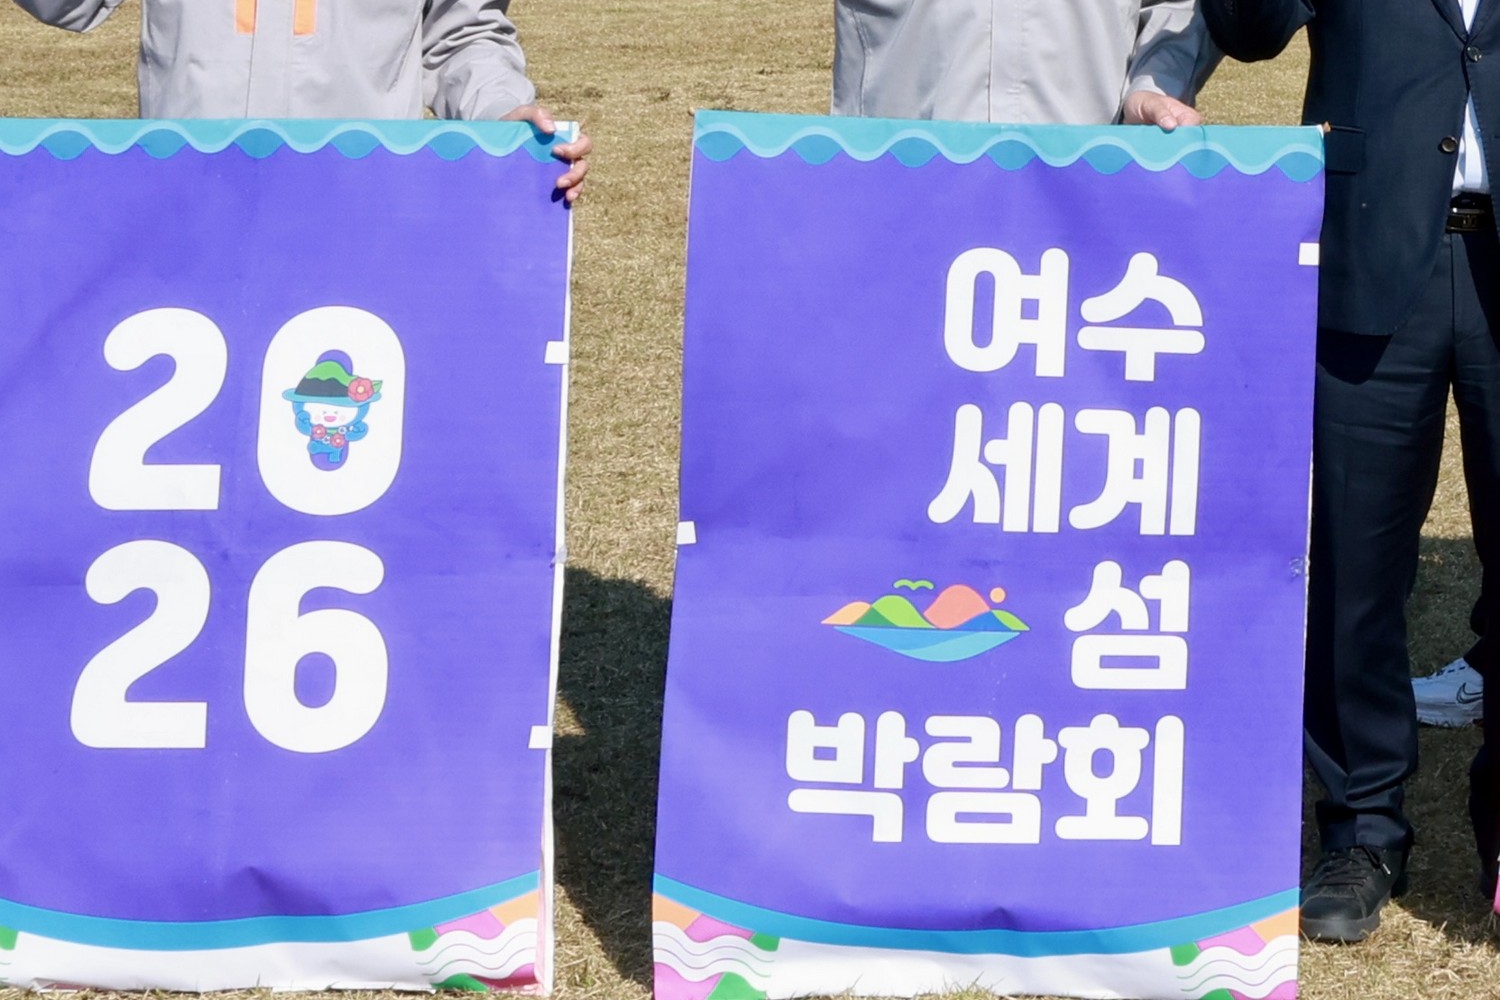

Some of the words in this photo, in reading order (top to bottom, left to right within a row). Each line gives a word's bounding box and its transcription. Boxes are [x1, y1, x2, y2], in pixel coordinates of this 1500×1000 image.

[943, 247, 1206, 382] 여수
[88, 305, 406, 516] 20
[927, 400, 1201, 536] 세계
[69, 538, 389, 753] 26
[1063, 559, 1191, 690] 섬
[785, 709, 1185, 846] 박람회
